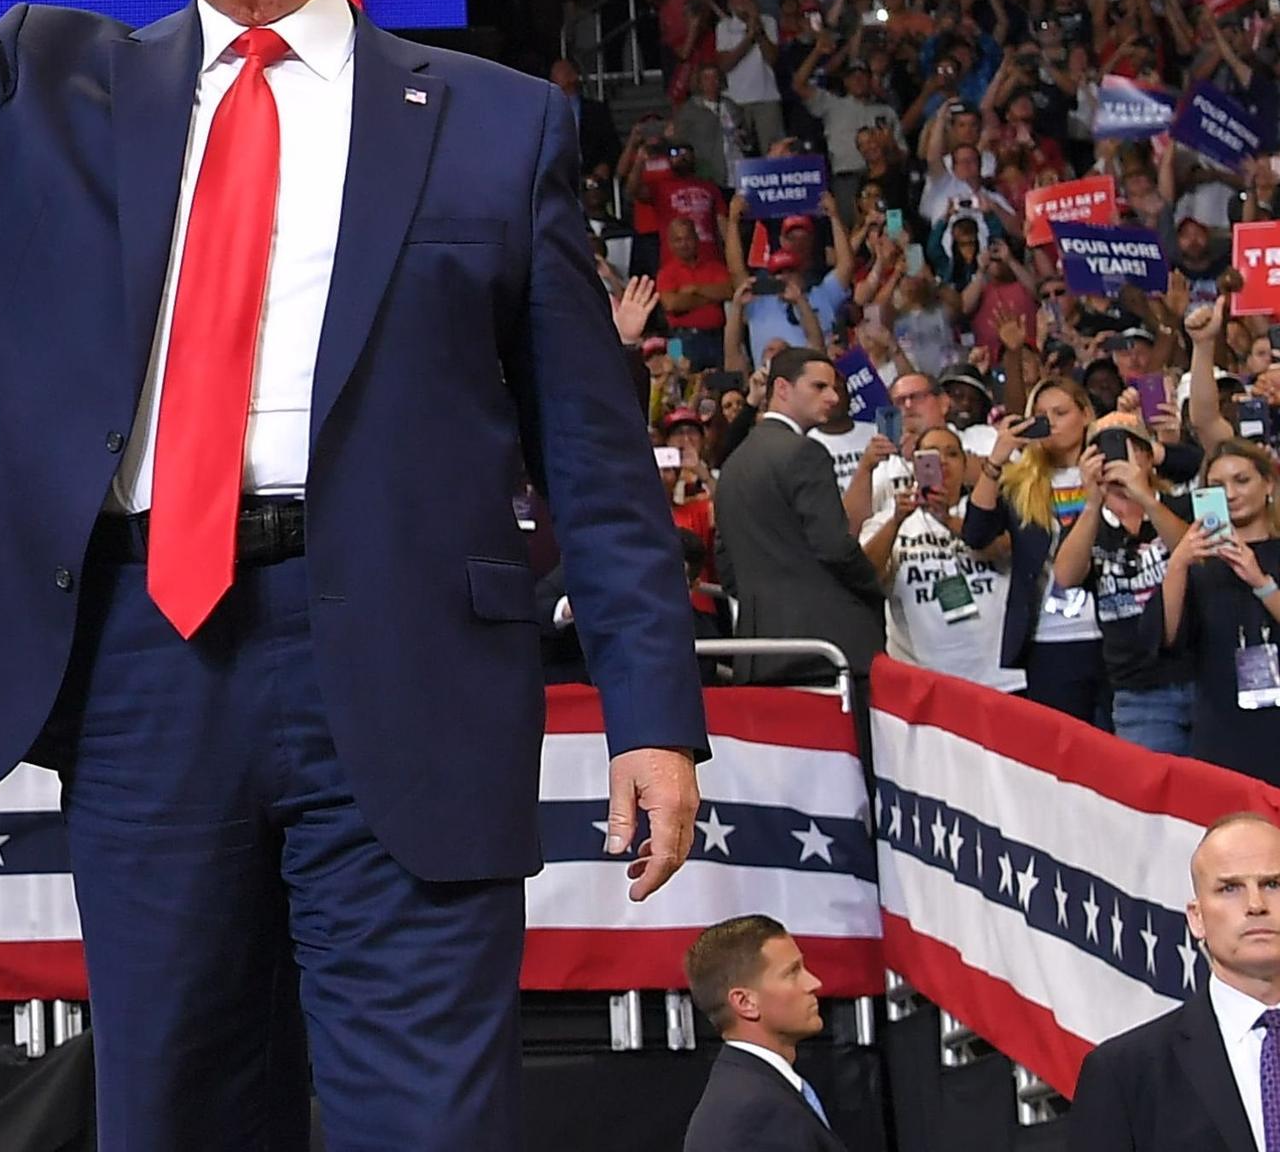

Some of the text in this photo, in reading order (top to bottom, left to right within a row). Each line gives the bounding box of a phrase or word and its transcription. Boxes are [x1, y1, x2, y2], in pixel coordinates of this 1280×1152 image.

[740, 169, 822, 189] FOUR MORE
[757, 186, 807, 203] YEARS!
[1034, 191, 1107, 216] TRUMP
[1061, 237, 1162, 260] FOUR MORE
[1086, 256, 1147, 277] YEARS!
